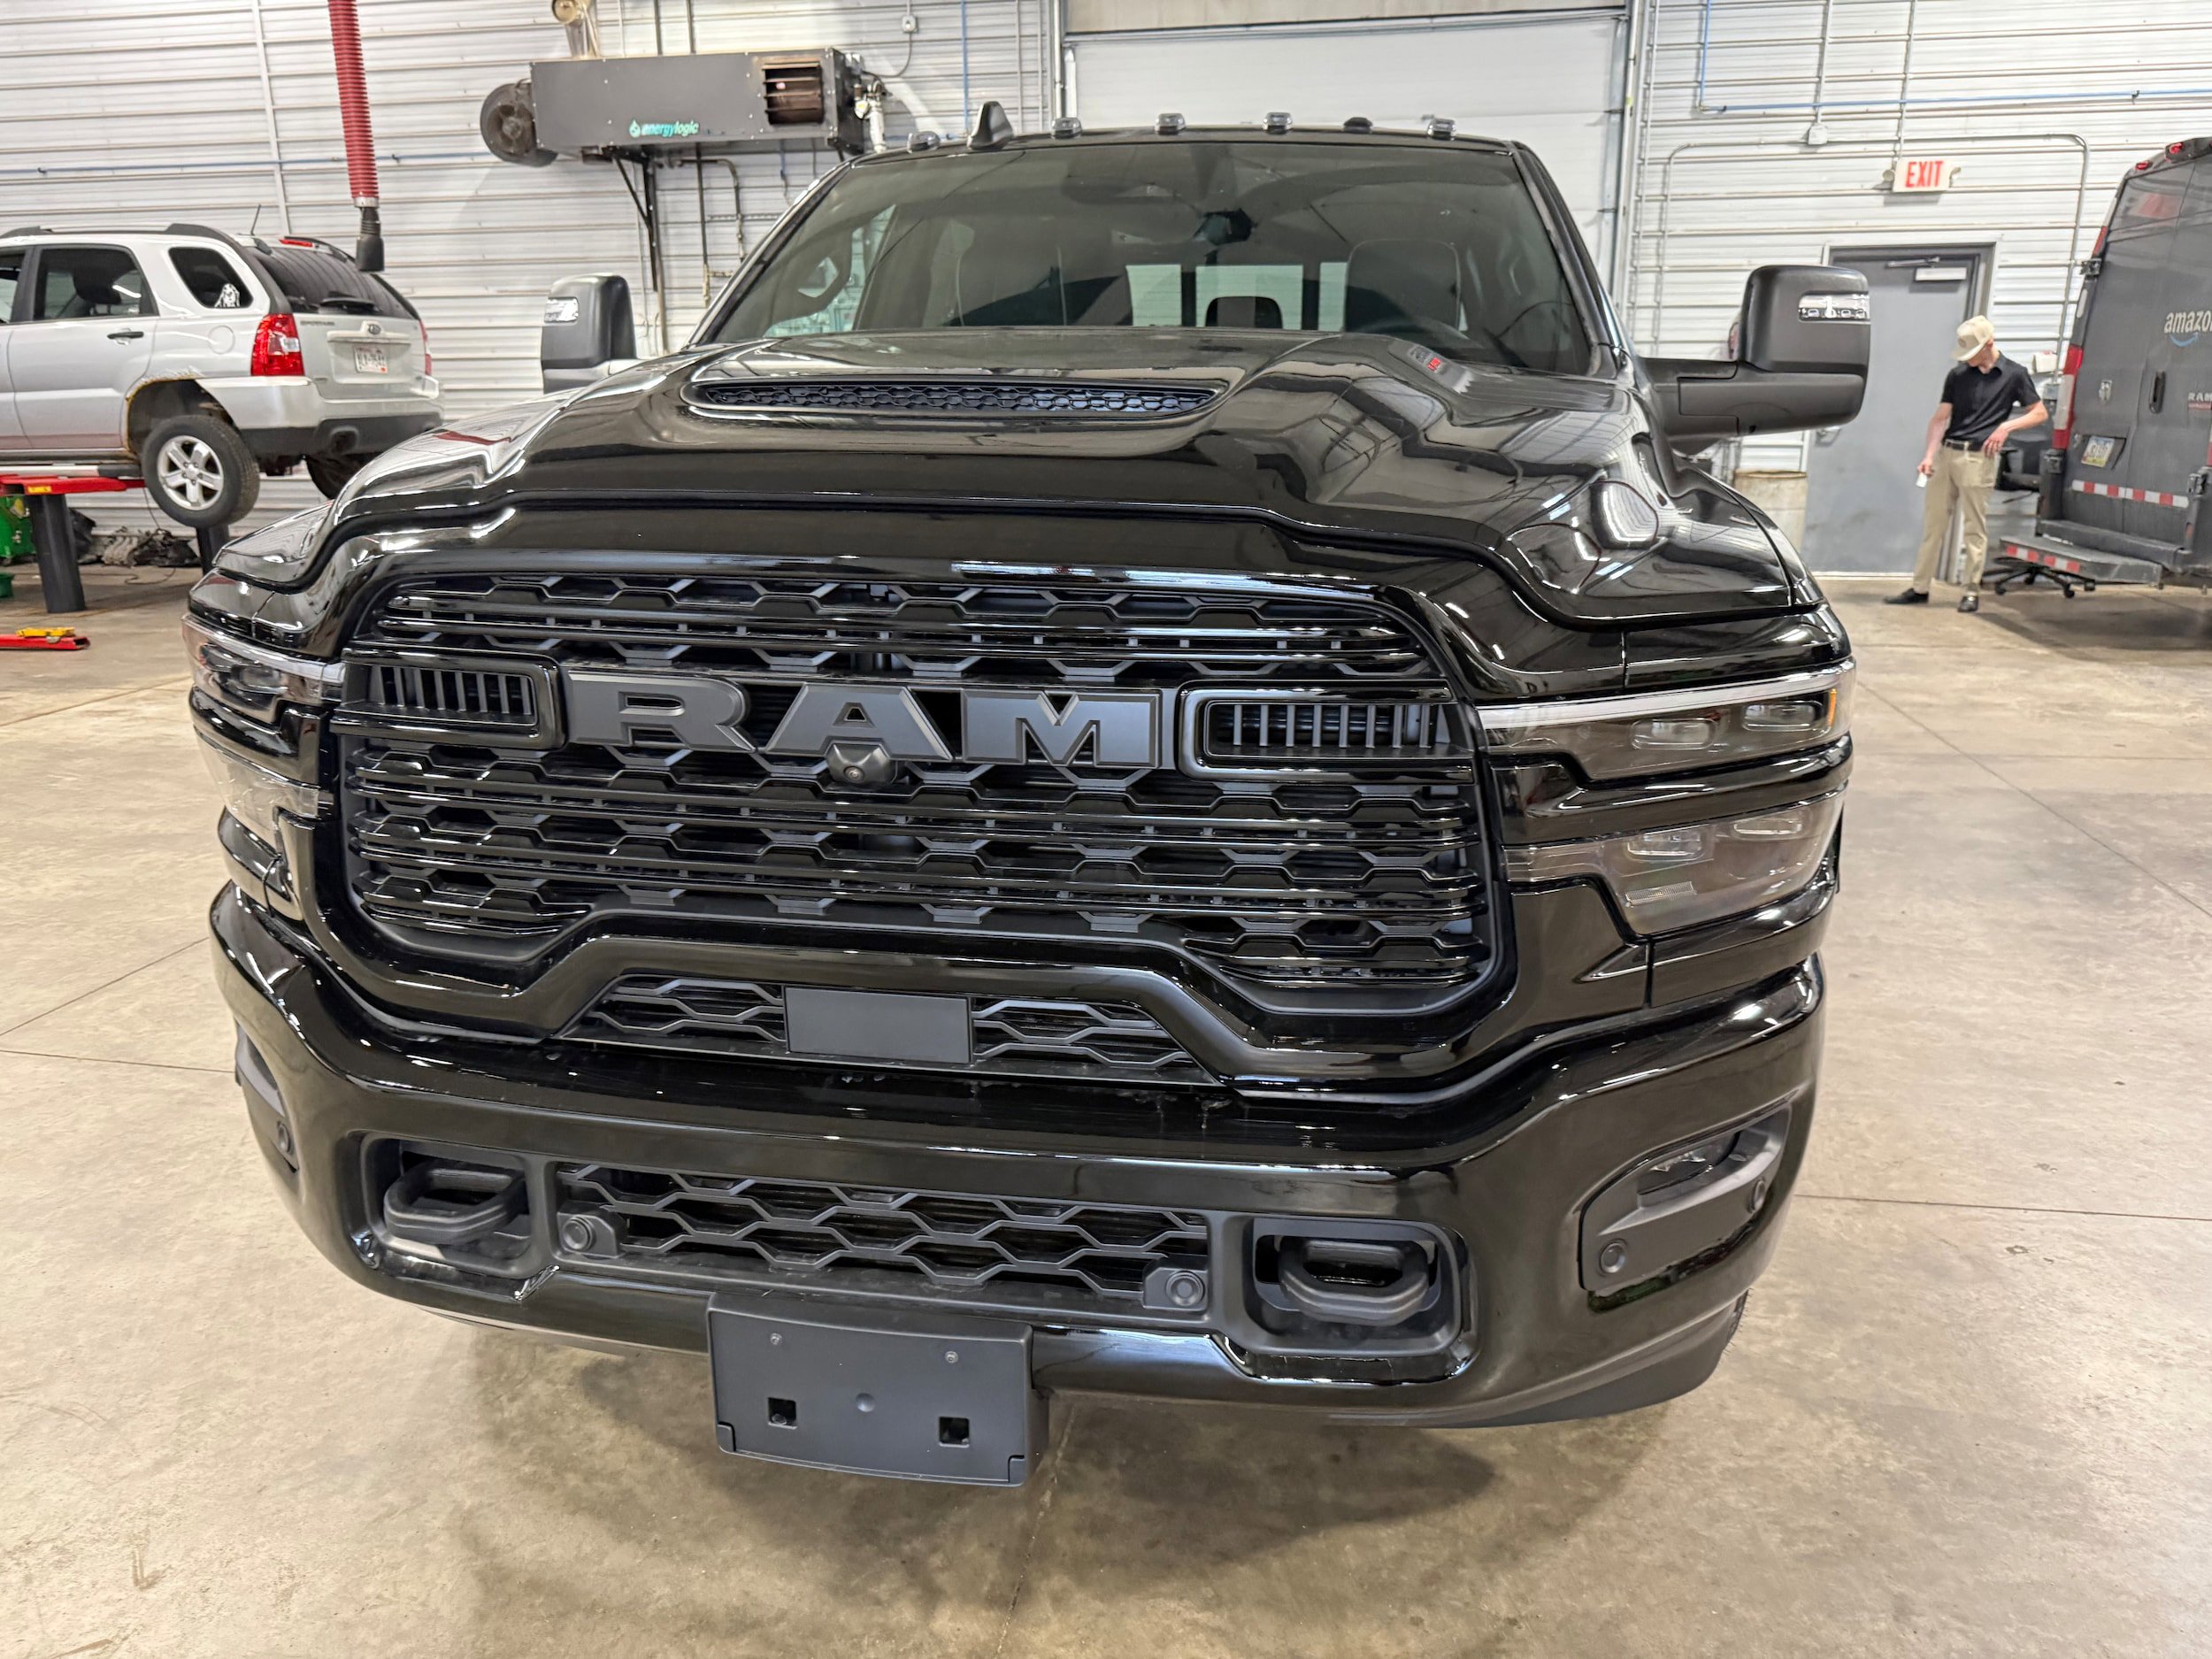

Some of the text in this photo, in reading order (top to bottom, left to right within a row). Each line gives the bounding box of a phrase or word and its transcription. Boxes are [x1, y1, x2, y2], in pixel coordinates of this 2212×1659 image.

[641, 120, 699, 137] energylogic
[1905, 160, 1944, 188] EXIT
[2163, 310, 2212, 334] amazo
[566, 669, 1161, 770] RAM
